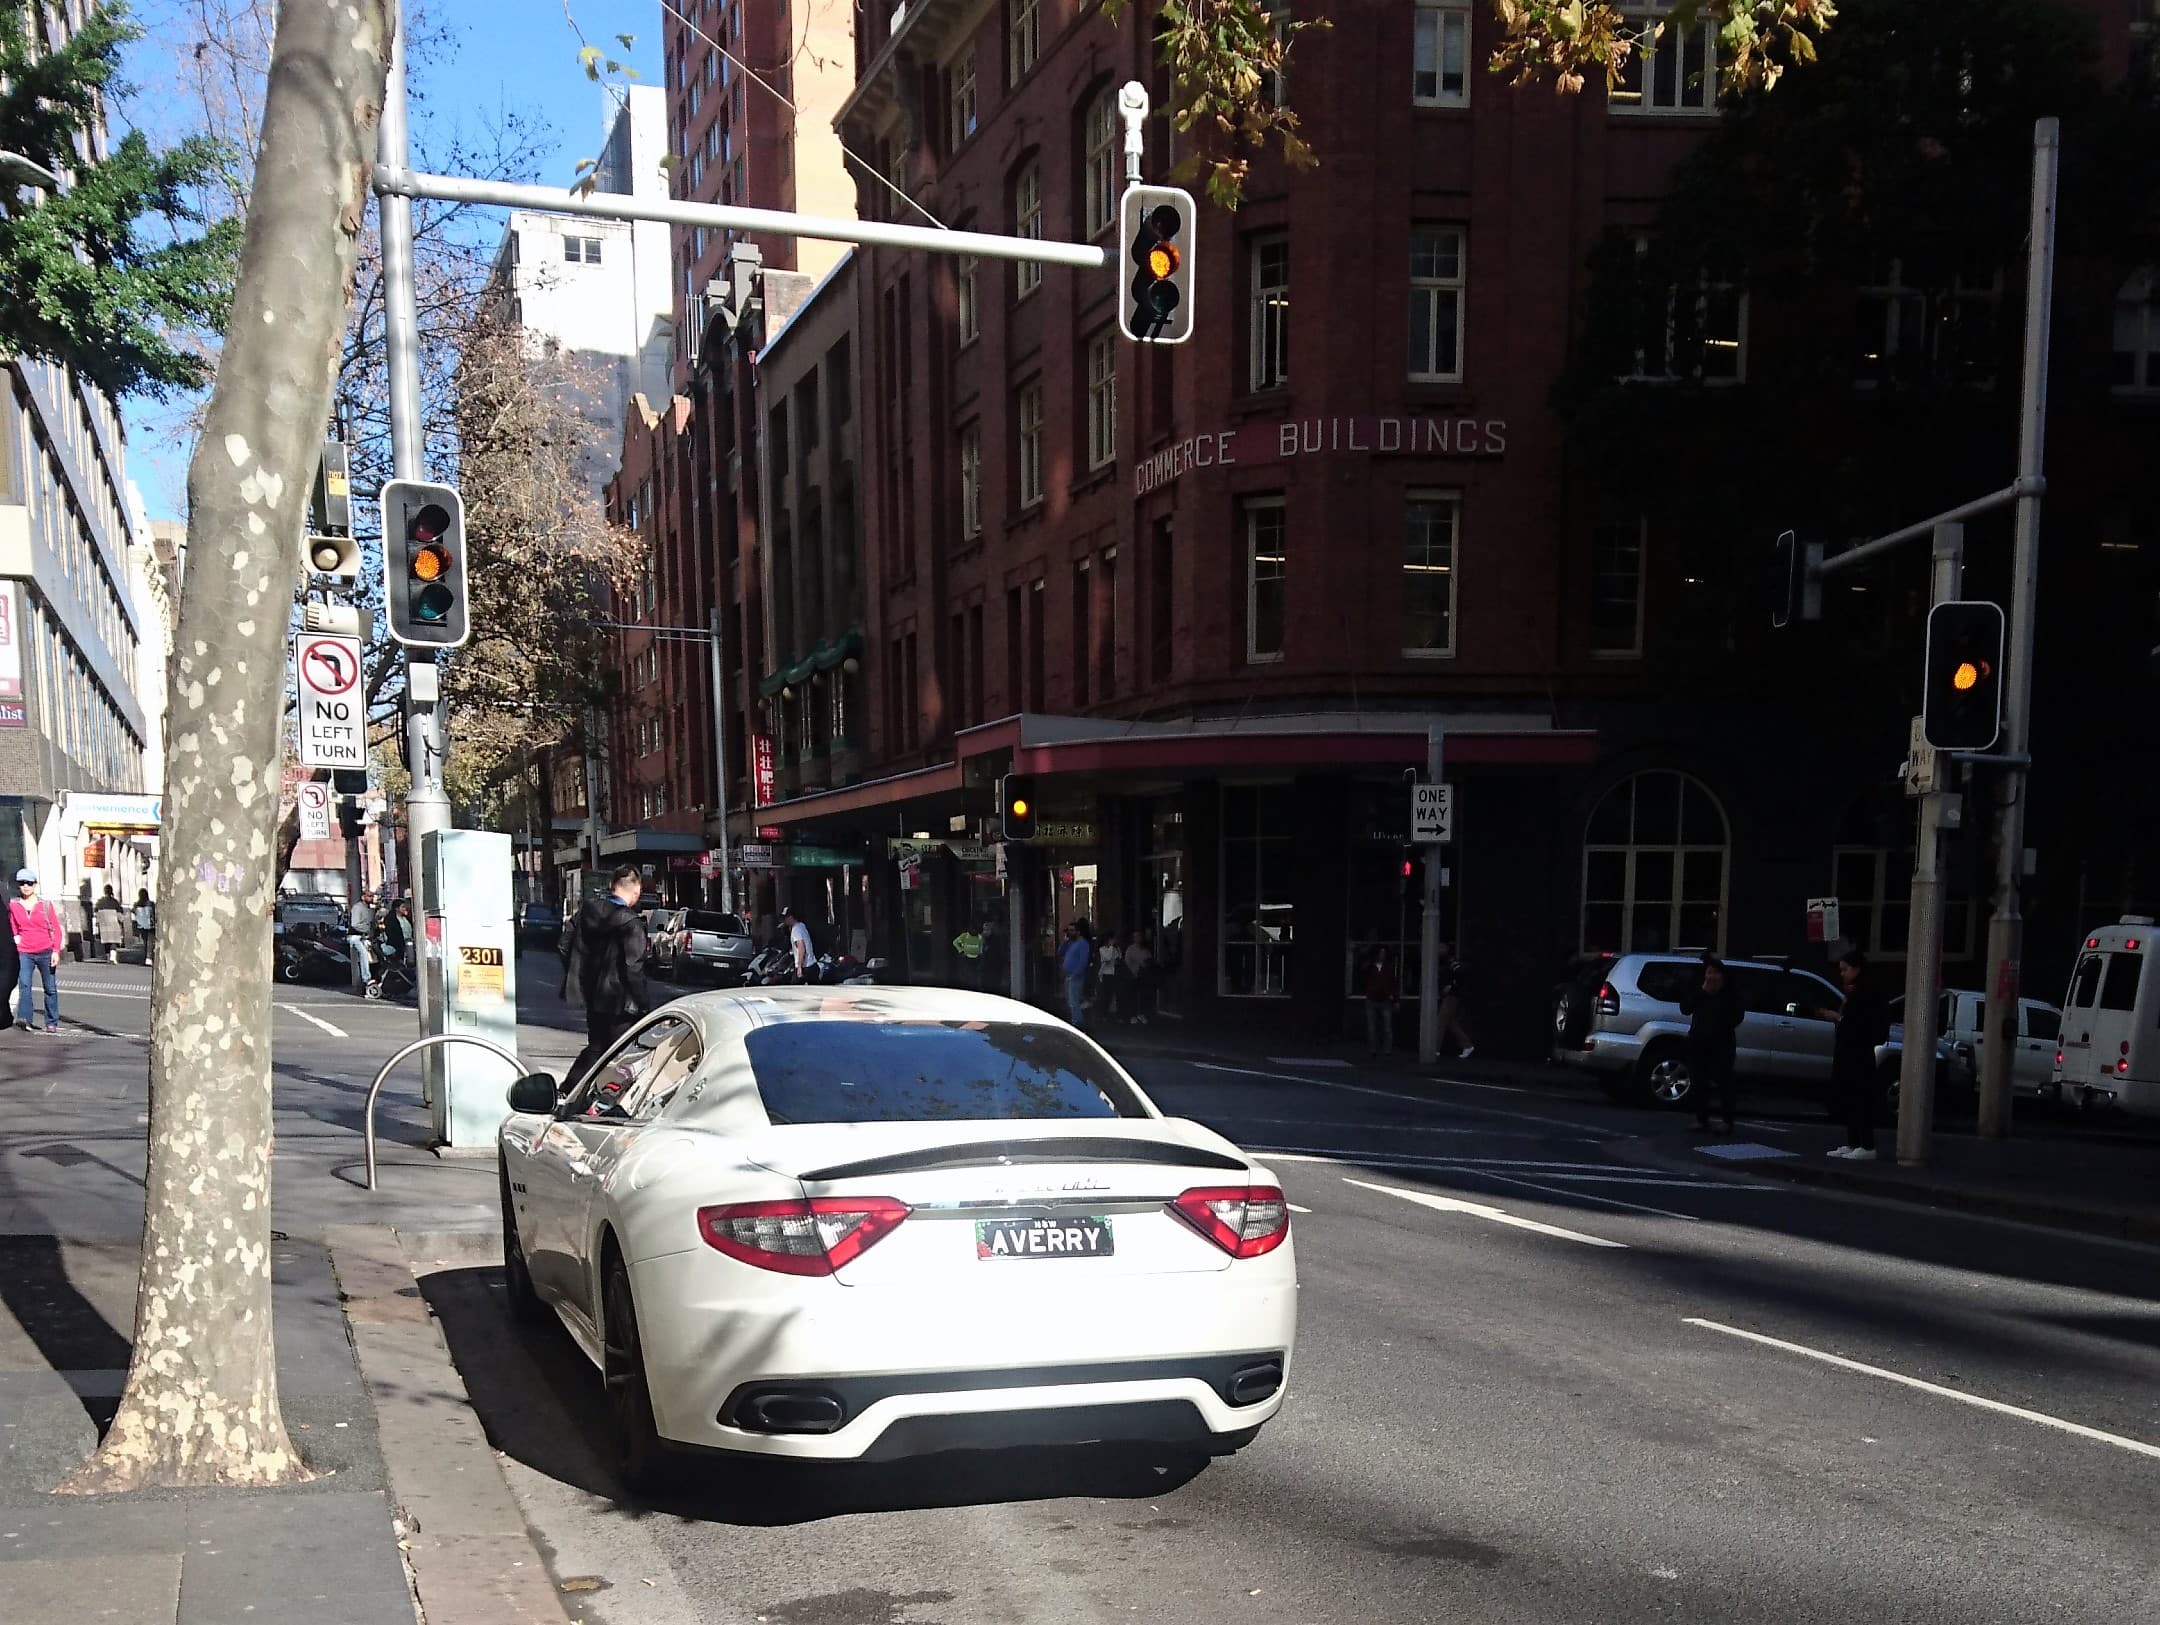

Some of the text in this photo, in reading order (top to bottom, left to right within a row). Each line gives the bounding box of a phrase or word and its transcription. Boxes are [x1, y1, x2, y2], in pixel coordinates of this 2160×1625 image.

[1136, 431, 1237, 495] COMMERCE
[316, 701, 349, 721] NO
[312, 725, 353, 740] LEFT
[312, 744, 356, 759] TURN
[759, 739, 776, 807] 壮壮肥牛
[1419, 789, 1446, 803] ONE
[308, 811, 323, 820] NO
[1416, 807, 1448, 820] WAY
[306, 821, 325, 829] LEFT
[307, 829, 327, 837] TURN
[462, 948, 498, 965] 2301
[991, 1227, 1101, 1253] AVERRY
